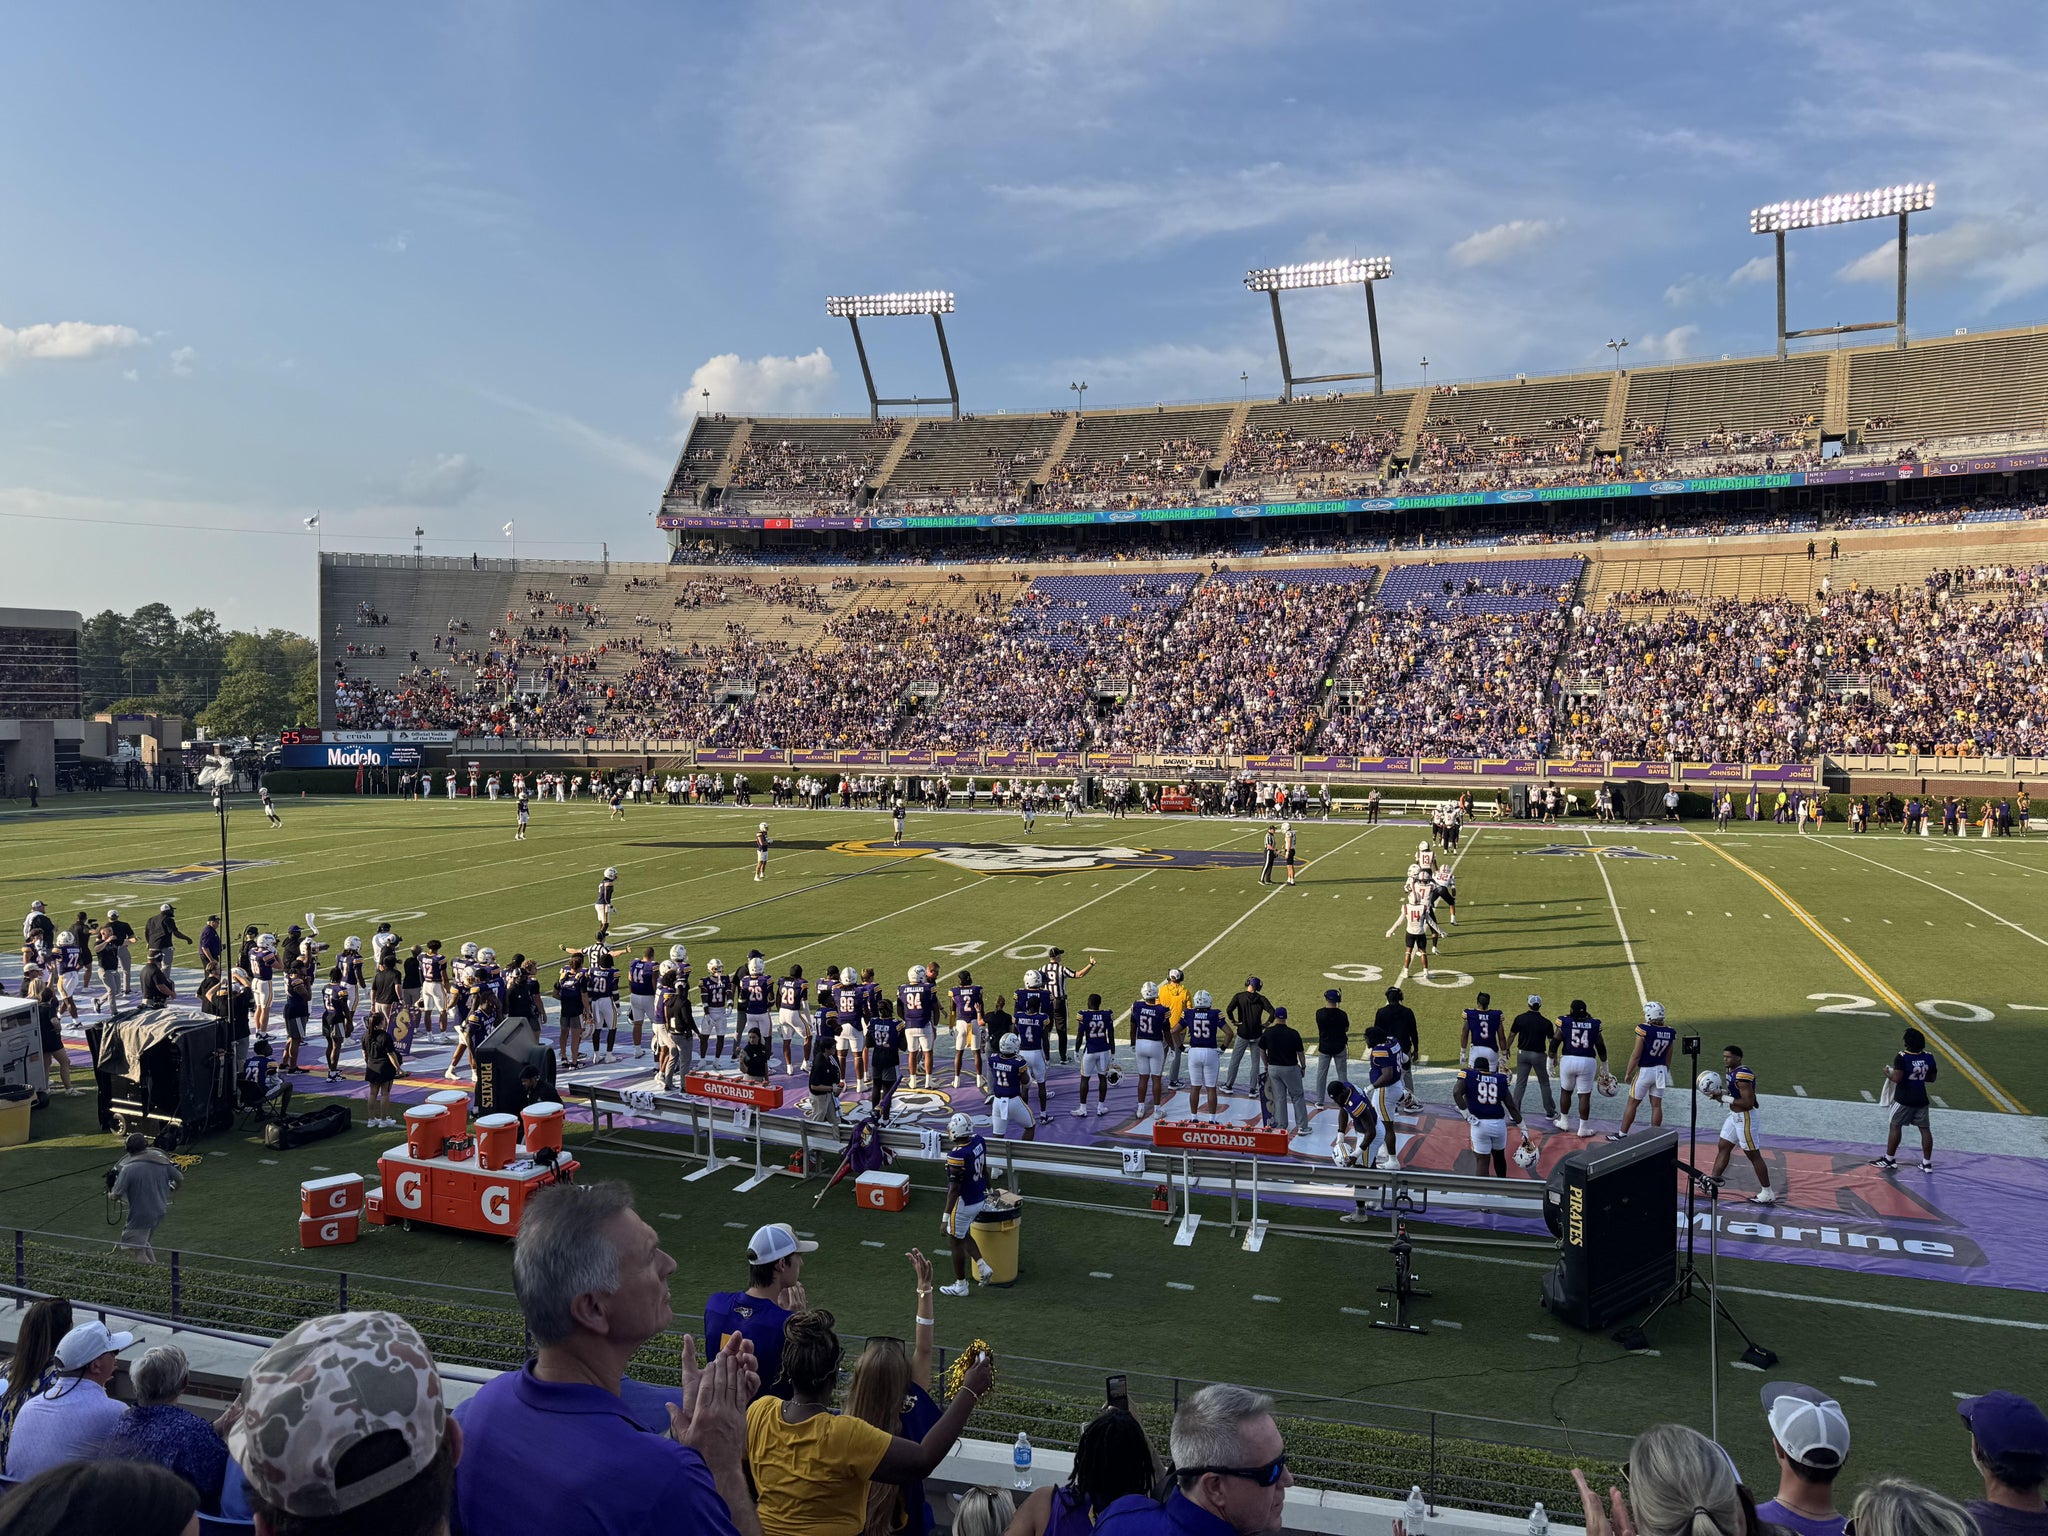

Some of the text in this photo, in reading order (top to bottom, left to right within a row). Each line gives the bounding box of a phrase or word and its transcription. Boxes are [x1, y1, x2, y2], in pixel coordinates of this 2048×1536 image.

[1949, 464, 1958, 472] 0
[1974, 462, 1996, 470] 0:02
[2009, 460, 2024, 468] 1st
[1690, 475, 1791, 491] PAIRMARINE.COM
[1539, 485, 1632, 499] PAIRMARINE.COM
[1265, 501, 1346, 515] PAIRMARINE.COM
[1397, 494, 1485, 509] PAIRMARINE.COM
[907, 517, 978, 527] PAIRMARINE.COM
[1022, 513, 1095, 525] PAIRMARINE.COM
[1141, 508, 1217, 520] PAIRMARINE.COM
[687, 519, 703, 527] 0:02
[775, 519, 782, 527] 0
[281, 732, 300, 744] 25
[327, 748, 382, 766] Modelo
[1422, 854, 1430, 865] 13
[1419, 889, 1426, 898] 7
[1410, 910, 1420, 922] 14
[607, 923, 721, 941] 50
[590, 950, 598, 963] S
[930, 940, 1055, 960] 40
[67, 953, 80, 968] 27
[423, 963, 433, 977] 12
[1322, 963, 1475, 988] 30
[593, 977, 607, 993] 20
[748, 986, 763, 1001] 26
[711, 988, 723, 1003] 14
[781, 987, 795, 1005] 28
[906, 992, 922, 1010] 94
[963, 995, 972, 1012] 2
[1140, 1008, 1156, 1017] POWELL
[1194, 1012, 1208, 1020] MOODY
[1806, 993, 1996, 1022] 20
[1089, 1020, 1105, 1038] 22
[1139, 1015, 1154, 1034] 51
[1193, 1019, 1210, 1039] 55
[1479, 1020, 1489, 1039] 3
[1025, 1025, 1034, 1042] 4
[1571, 1028, 1589, 1048] 54
[1649, 1038, 1670, 1057] 97
[246, 1066, 260, 1083] 23
[996, 1070, 1010, 1087] 11
[480, 1061, 494, 1109] PIRATES
[704, 1082, 756, 1101] GATORADE
[1477, 1081, 1498, 1105] 99
[1182, 1131, 1256, 1148] GATORADE
[329, 1189, 347, 1209] G
[395, 1171, 422, 1210] G
[869, 1189, 885, 1206] G
[481, 1185, 510, 1225] G
[1569, 1184, 1583, 1248] PIRATES
[320, 1222, 339, 1241] G
[1676, 1212, 1956, 1259] Marine
